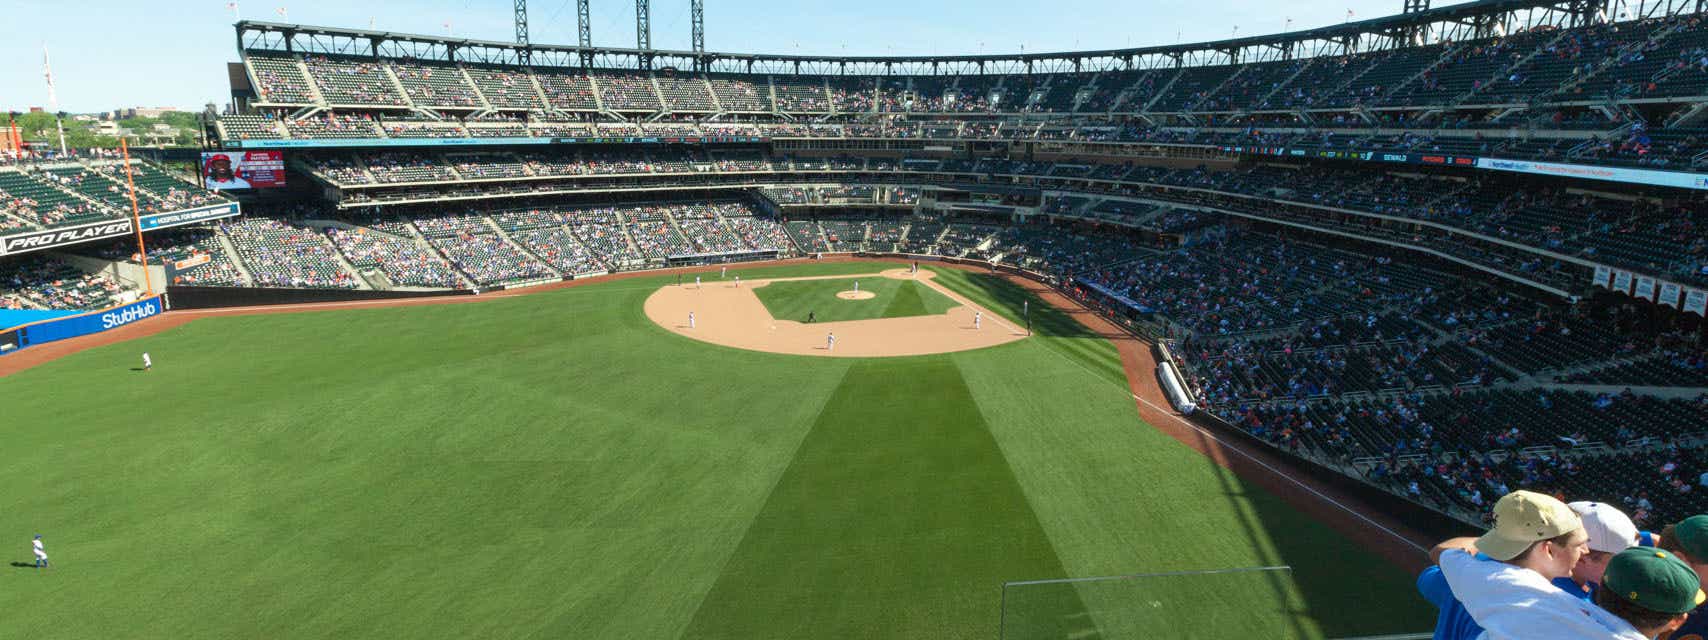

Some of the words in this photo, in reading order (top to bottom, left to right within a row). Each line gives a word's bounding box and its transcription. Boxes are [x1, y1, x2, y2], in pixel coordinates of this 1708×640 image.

[157, 215, 180, 224] HOSPITAL
[7, 234, 56, 250] PRO
[57, 222, 131, 242] PLAYER
[102, 303, 156, 328] StubHub
